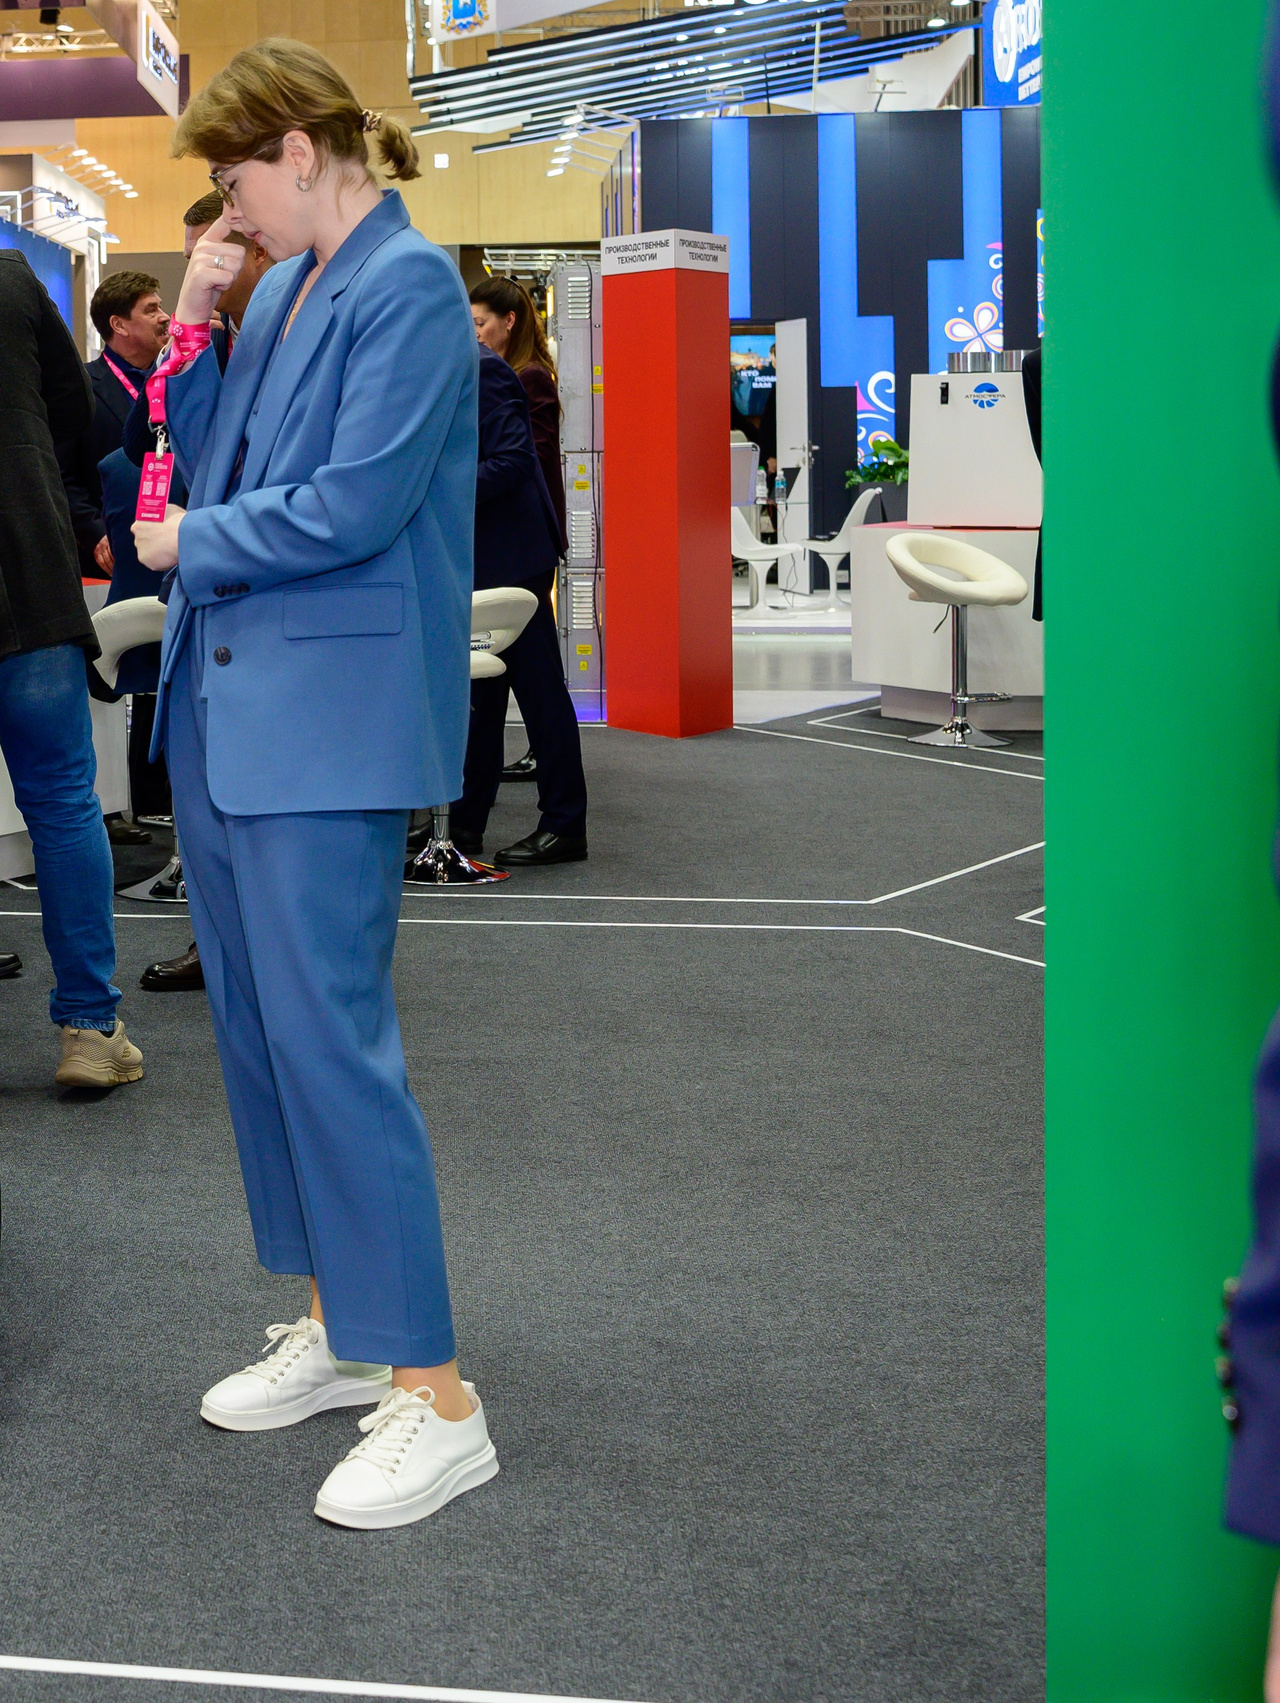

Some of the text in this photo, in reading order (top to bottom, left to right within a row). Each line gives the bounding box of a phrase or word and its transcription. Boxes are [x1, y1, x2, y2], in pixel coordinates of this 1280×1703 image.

[604, 238, 670, 255] ПРОИЗВОДСТВЕННЫЕ
[678, 238, 727, 253] ПРОИЗВОДСТВЕННЫЕ
[617, 252, 658, 265] ТЕХНОЛОГИИ
[688, 251, 719, 263] ТЕХНОЛОГИИ
